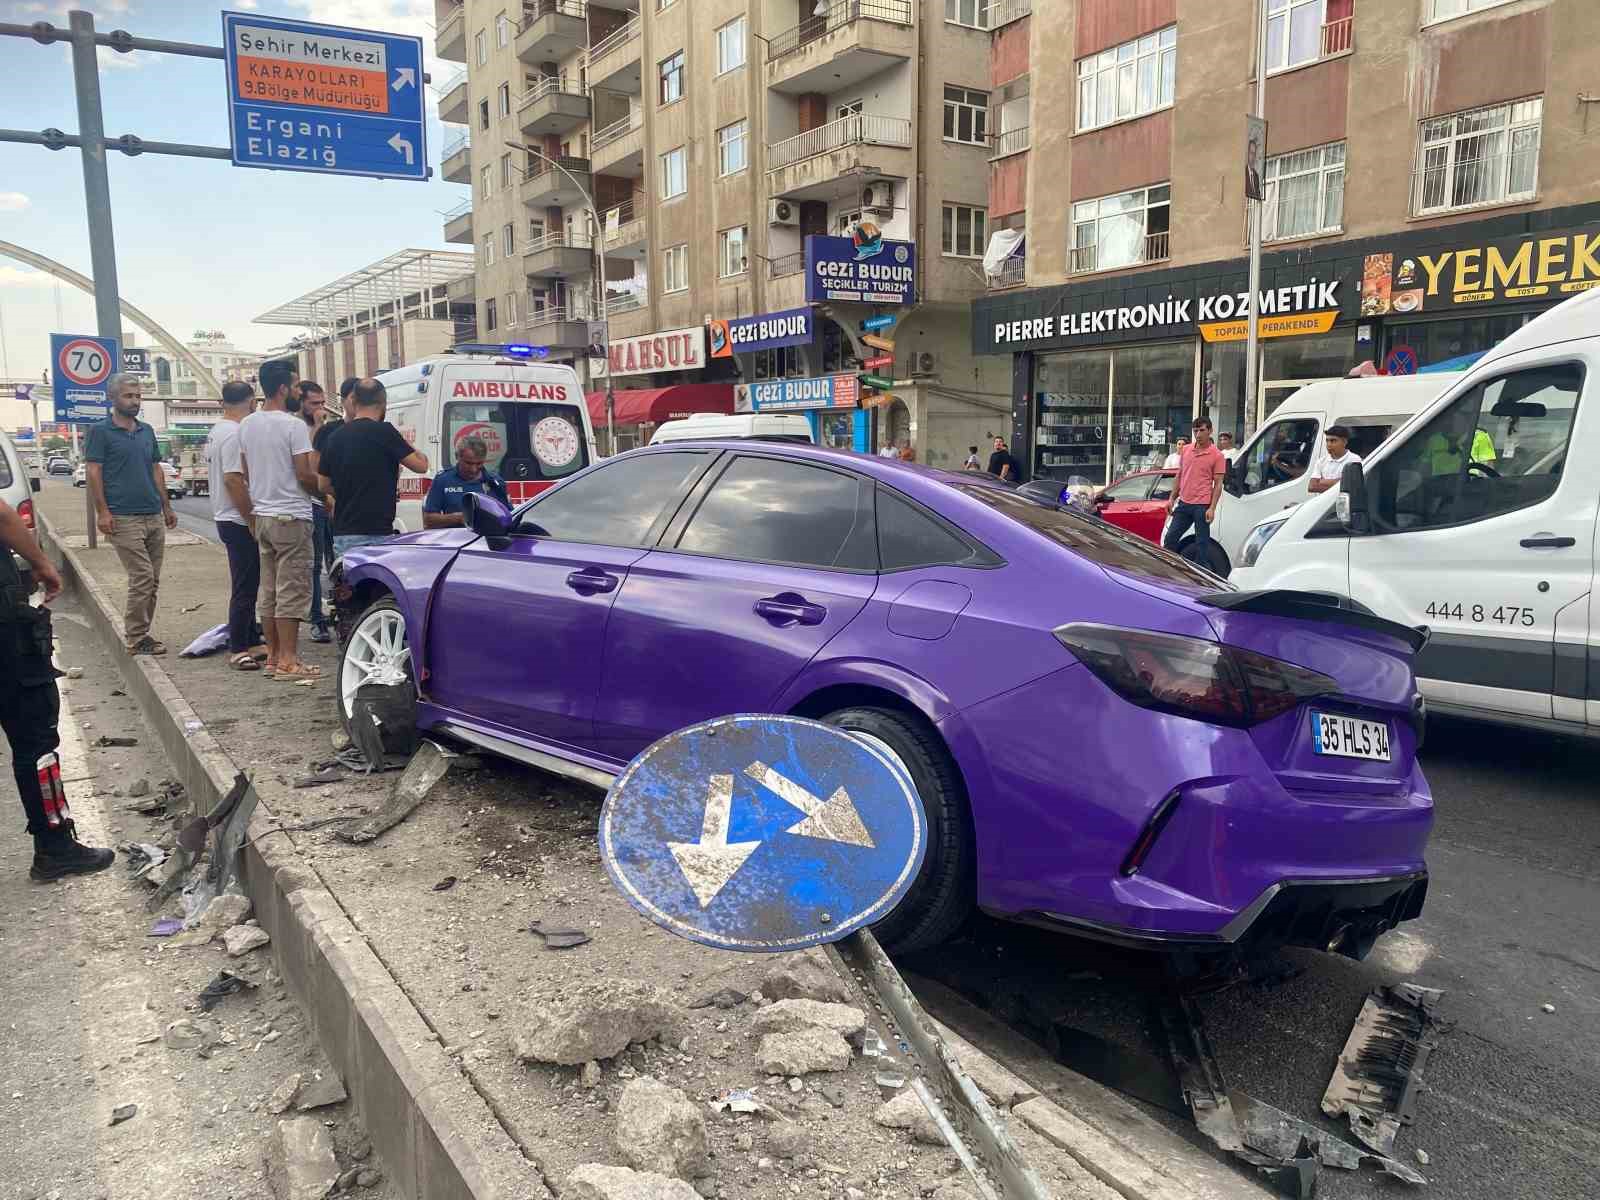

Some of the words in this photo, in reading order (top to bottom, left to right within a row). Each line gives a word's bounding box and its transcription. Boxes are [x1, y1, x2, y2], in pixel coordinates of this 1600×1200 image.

[240, 33, 295, 55] Şehir
[303, 41, 381, 65] Merkezi
[250, 63, 365, 88] KARAYOLLARI
[303, 87, 381, 109] Müdürlüğü
[247, 112, 342, 139] Ergani
[248, 137, 336, 167] Elazığ
[858, 263, 913, 282] BUDUR
[1417, 233, 1600, 296] YEMEK
[1060, 294, 1191, 336] ELEKTRONİK
[1199, 277, 1340, 320] KOZMETİK
[759, 316, 806, 340] BUDUR
[1262, 319, 1320, 333] PERAKENDE
[71, 352, 103, 372] 70
[608, 333, 697, 374] MAHSUL
[452, 382, 568, 401] AMBULANS
[785, 379, 831, 401] BUDUR
[1425, 602, 1464, 621] 444
[1472, 605, 1484, 622] 8
[1492, 606, 1535, 626] 475
[1321, 717, 1339, 751] 35
[1342, 720, 1371, 754] HLS
[1374, 726, 1389, 757] 34
